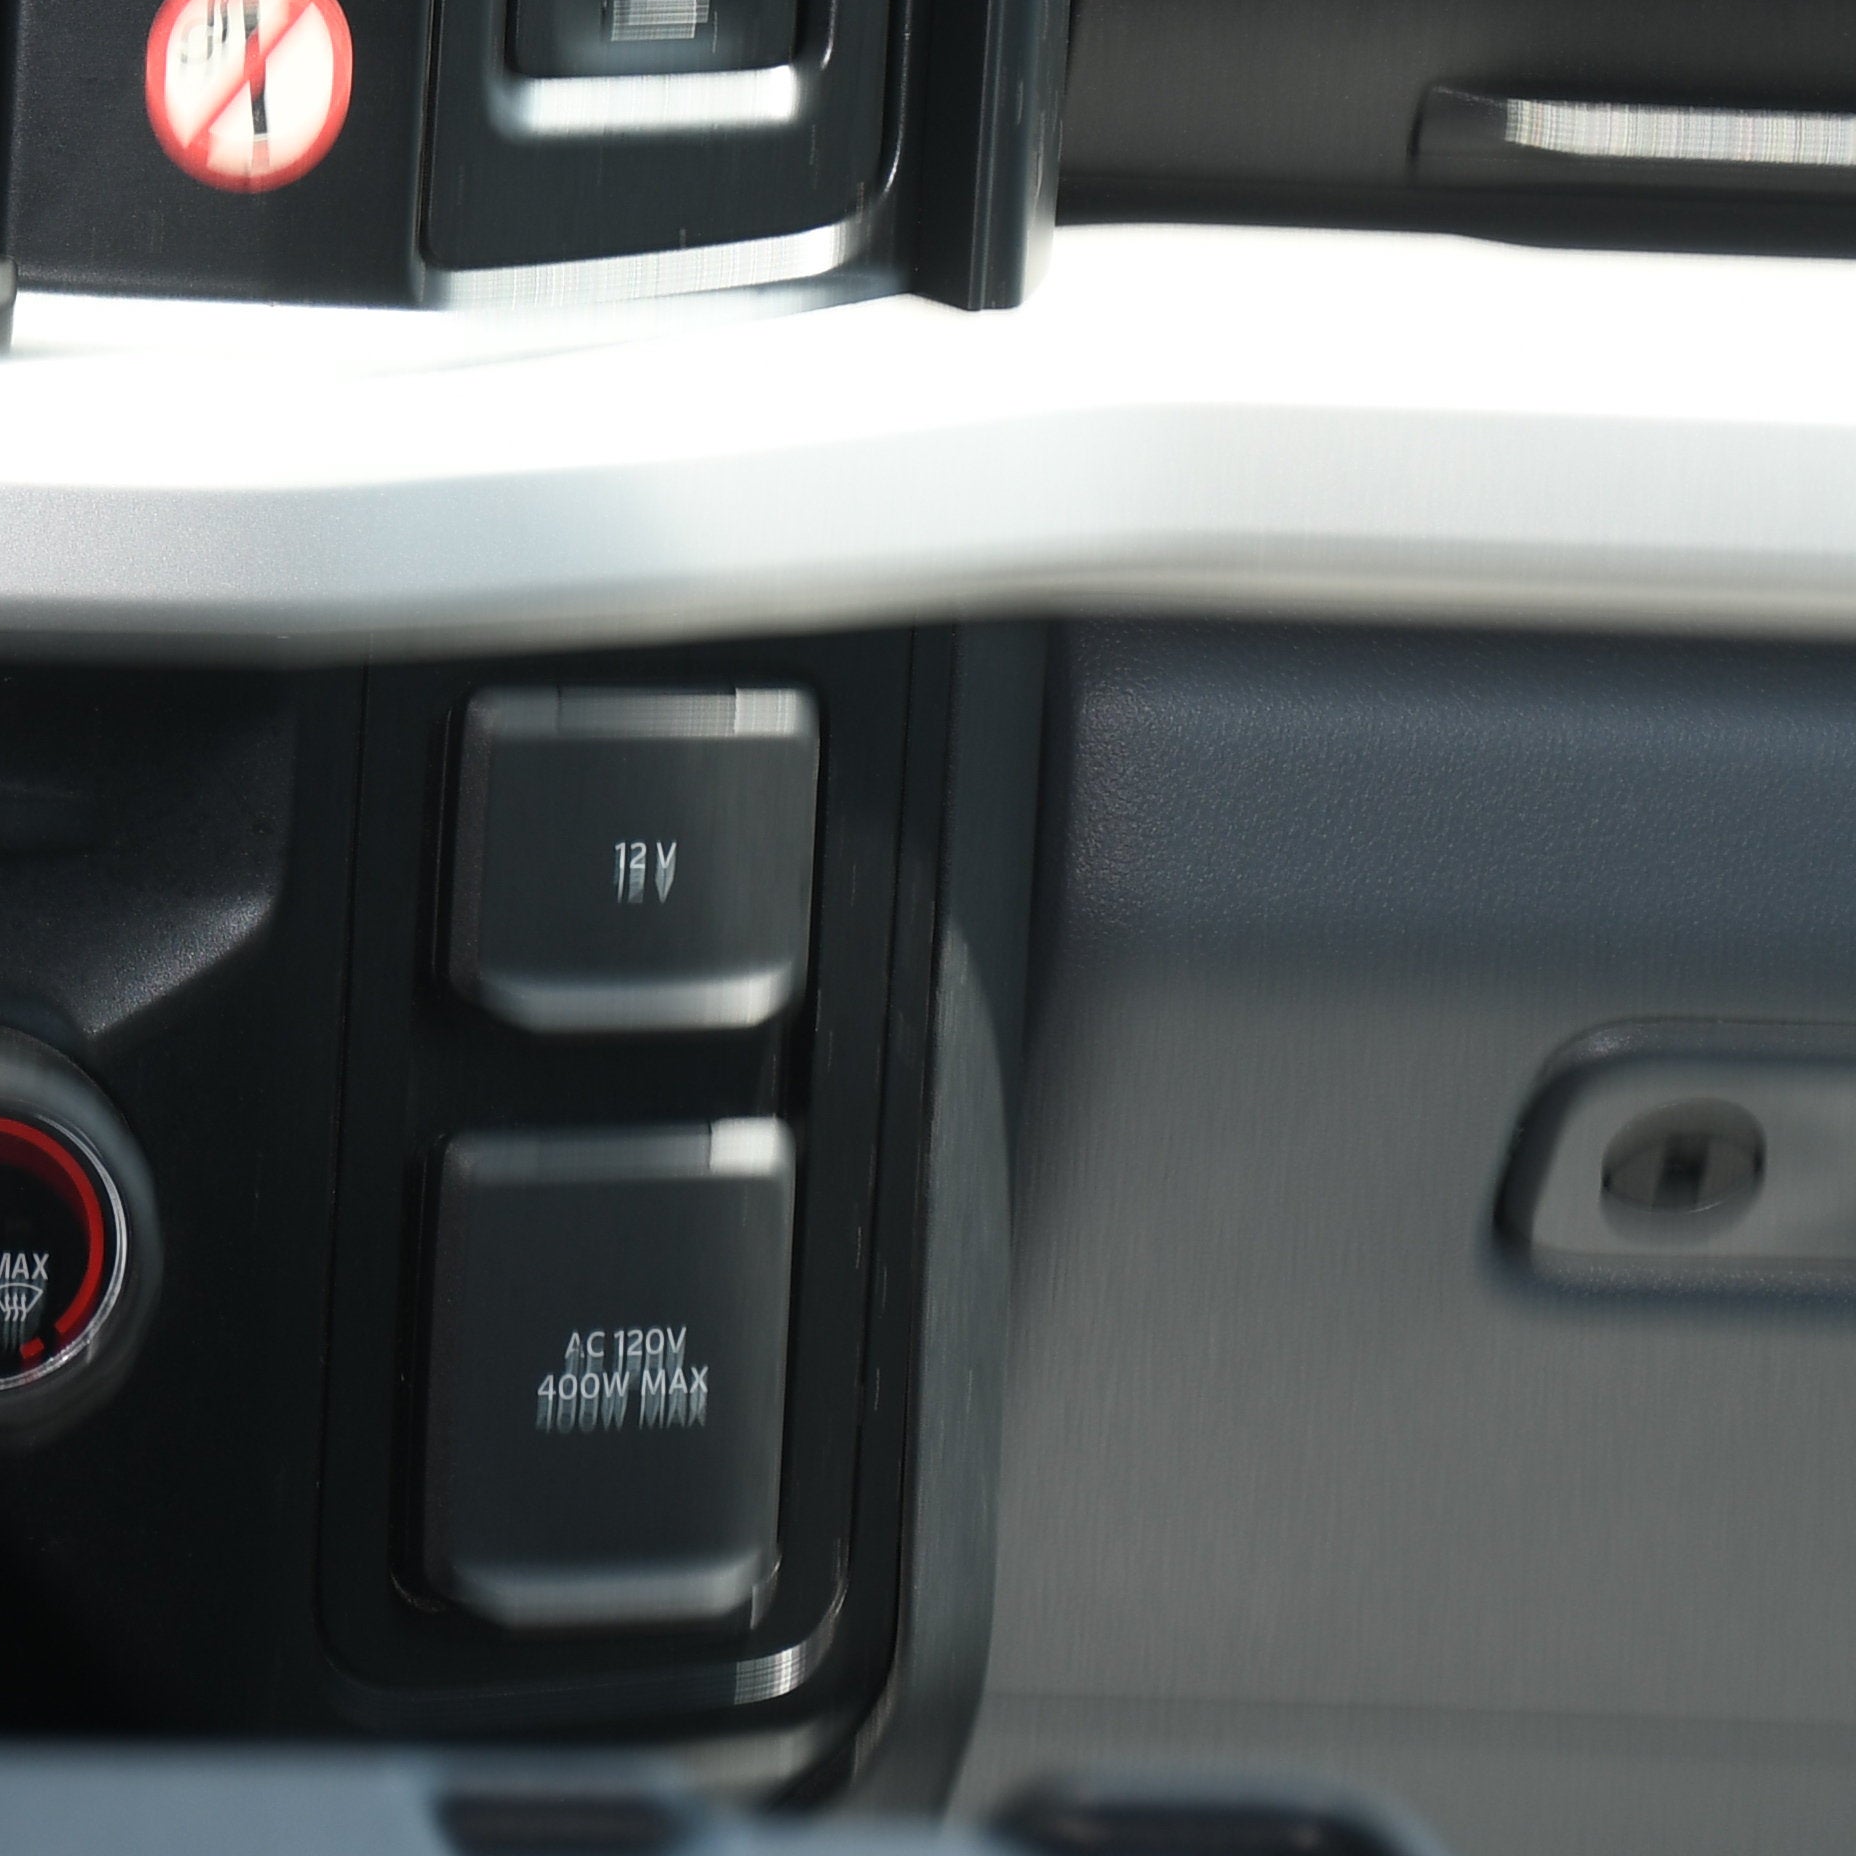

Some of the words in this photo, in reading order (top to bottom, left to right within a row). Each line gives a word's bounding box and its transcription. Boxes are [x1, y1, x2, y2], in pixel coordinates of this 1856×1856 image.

[565, 1331, 605, 1358] AC
[614, 1327, 686, 1357] 120V
[537, 1371, 630, 1401] 400W
[641, 1366, 709, 1395] MAX
